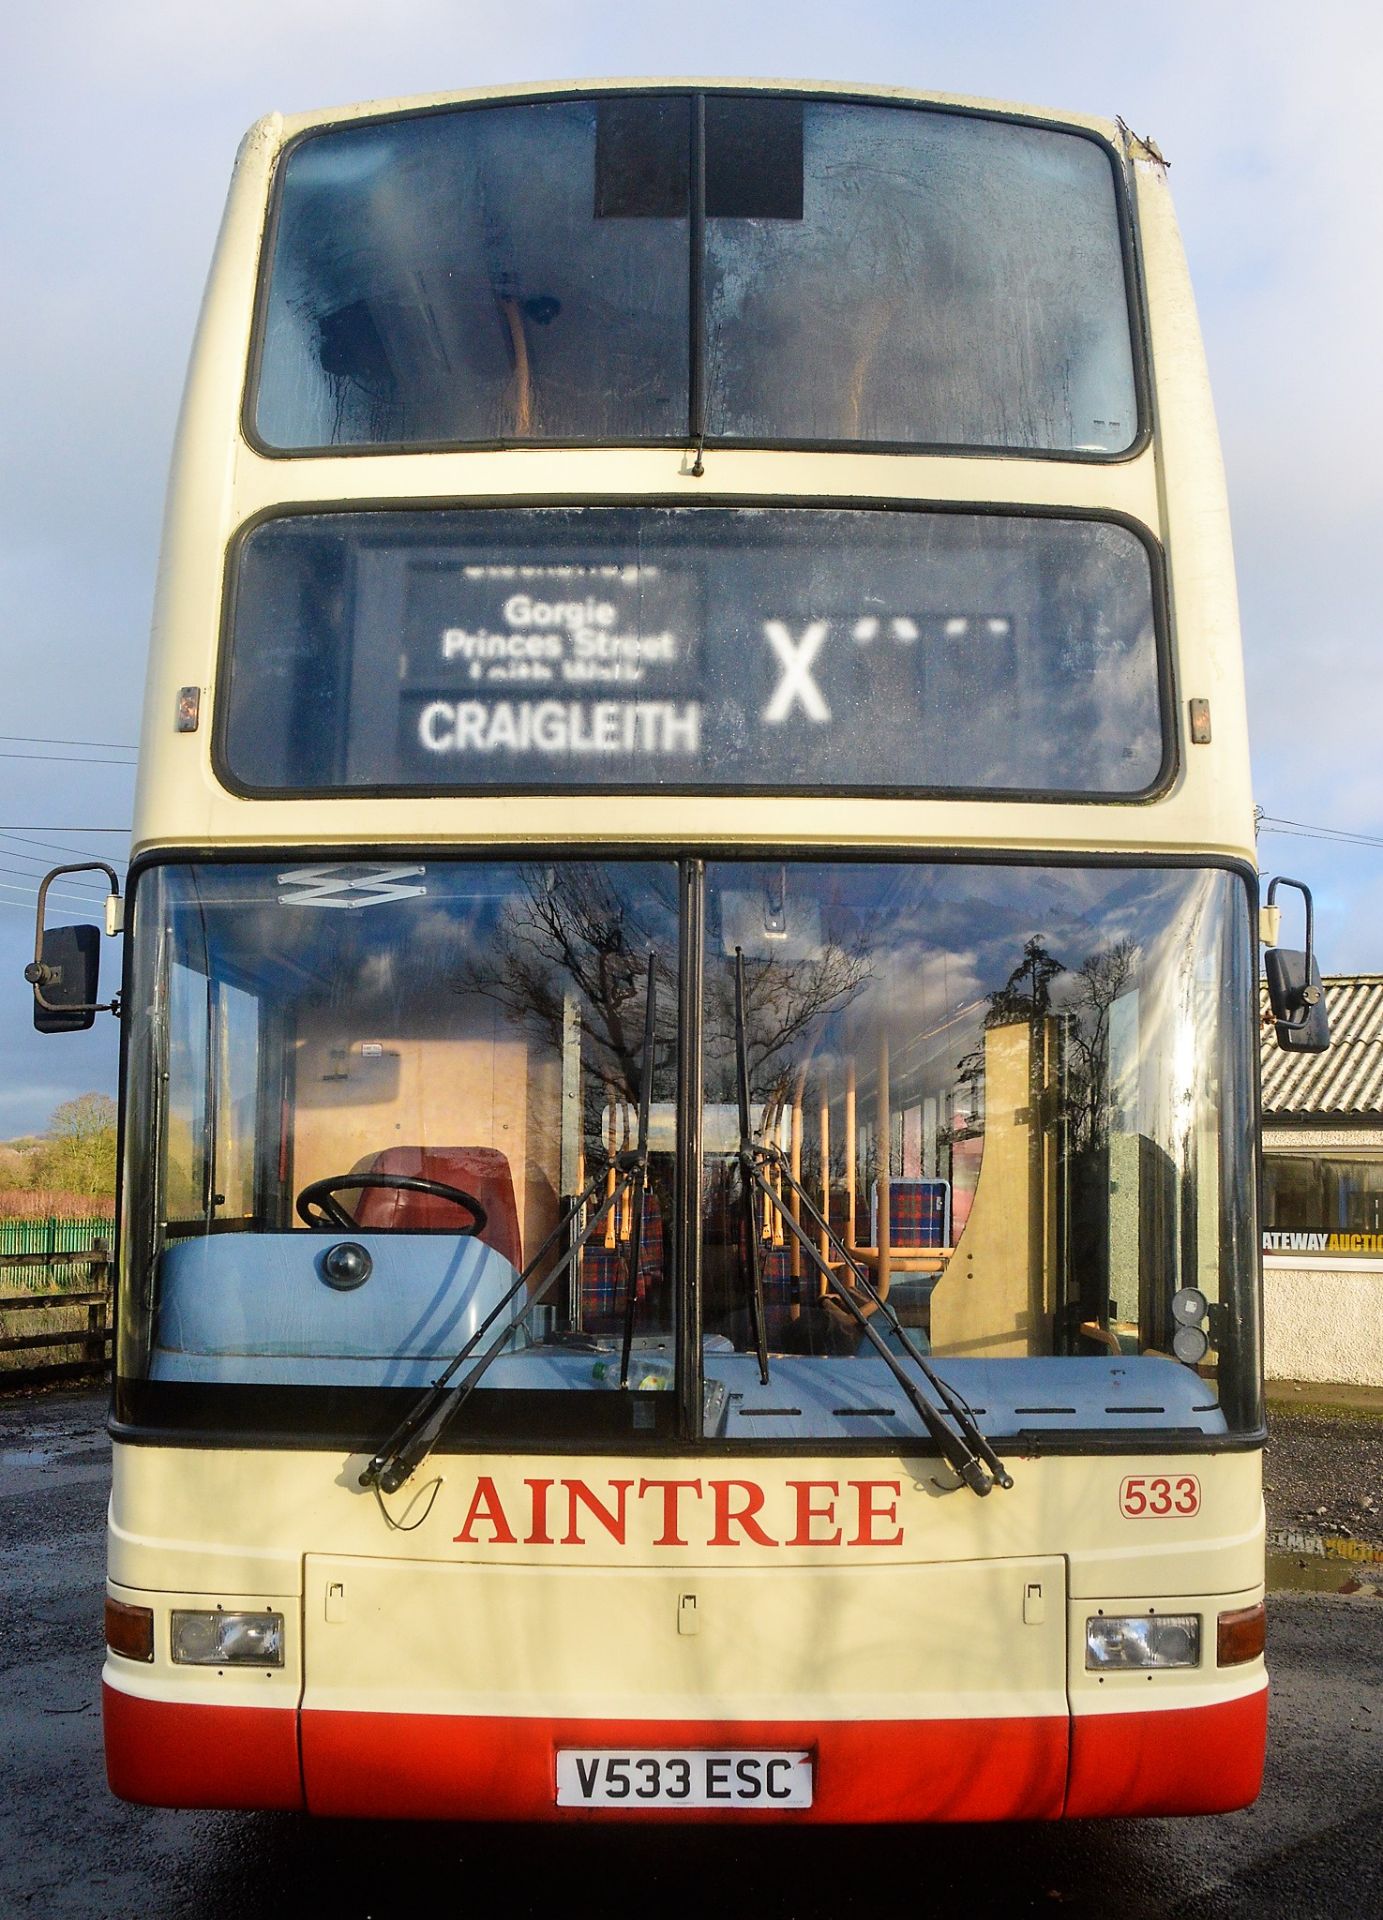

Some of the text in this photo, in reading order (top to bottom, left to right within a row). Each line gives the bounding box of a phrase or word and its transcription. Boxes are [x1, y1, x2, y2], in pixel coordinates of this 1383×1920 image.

[504, 594, 617, 629] Gorgie
[443, 629, 676, 658] Princes Street
[762, 619, 832, 724] X
[418, 700, 699, 752] CRAIGLEITH
[453, 1476, 904, 1547] AINTREE
[1124, 1477, 1198, 1515] 533
[575, 1758, 792, 1799] V533 ESC
